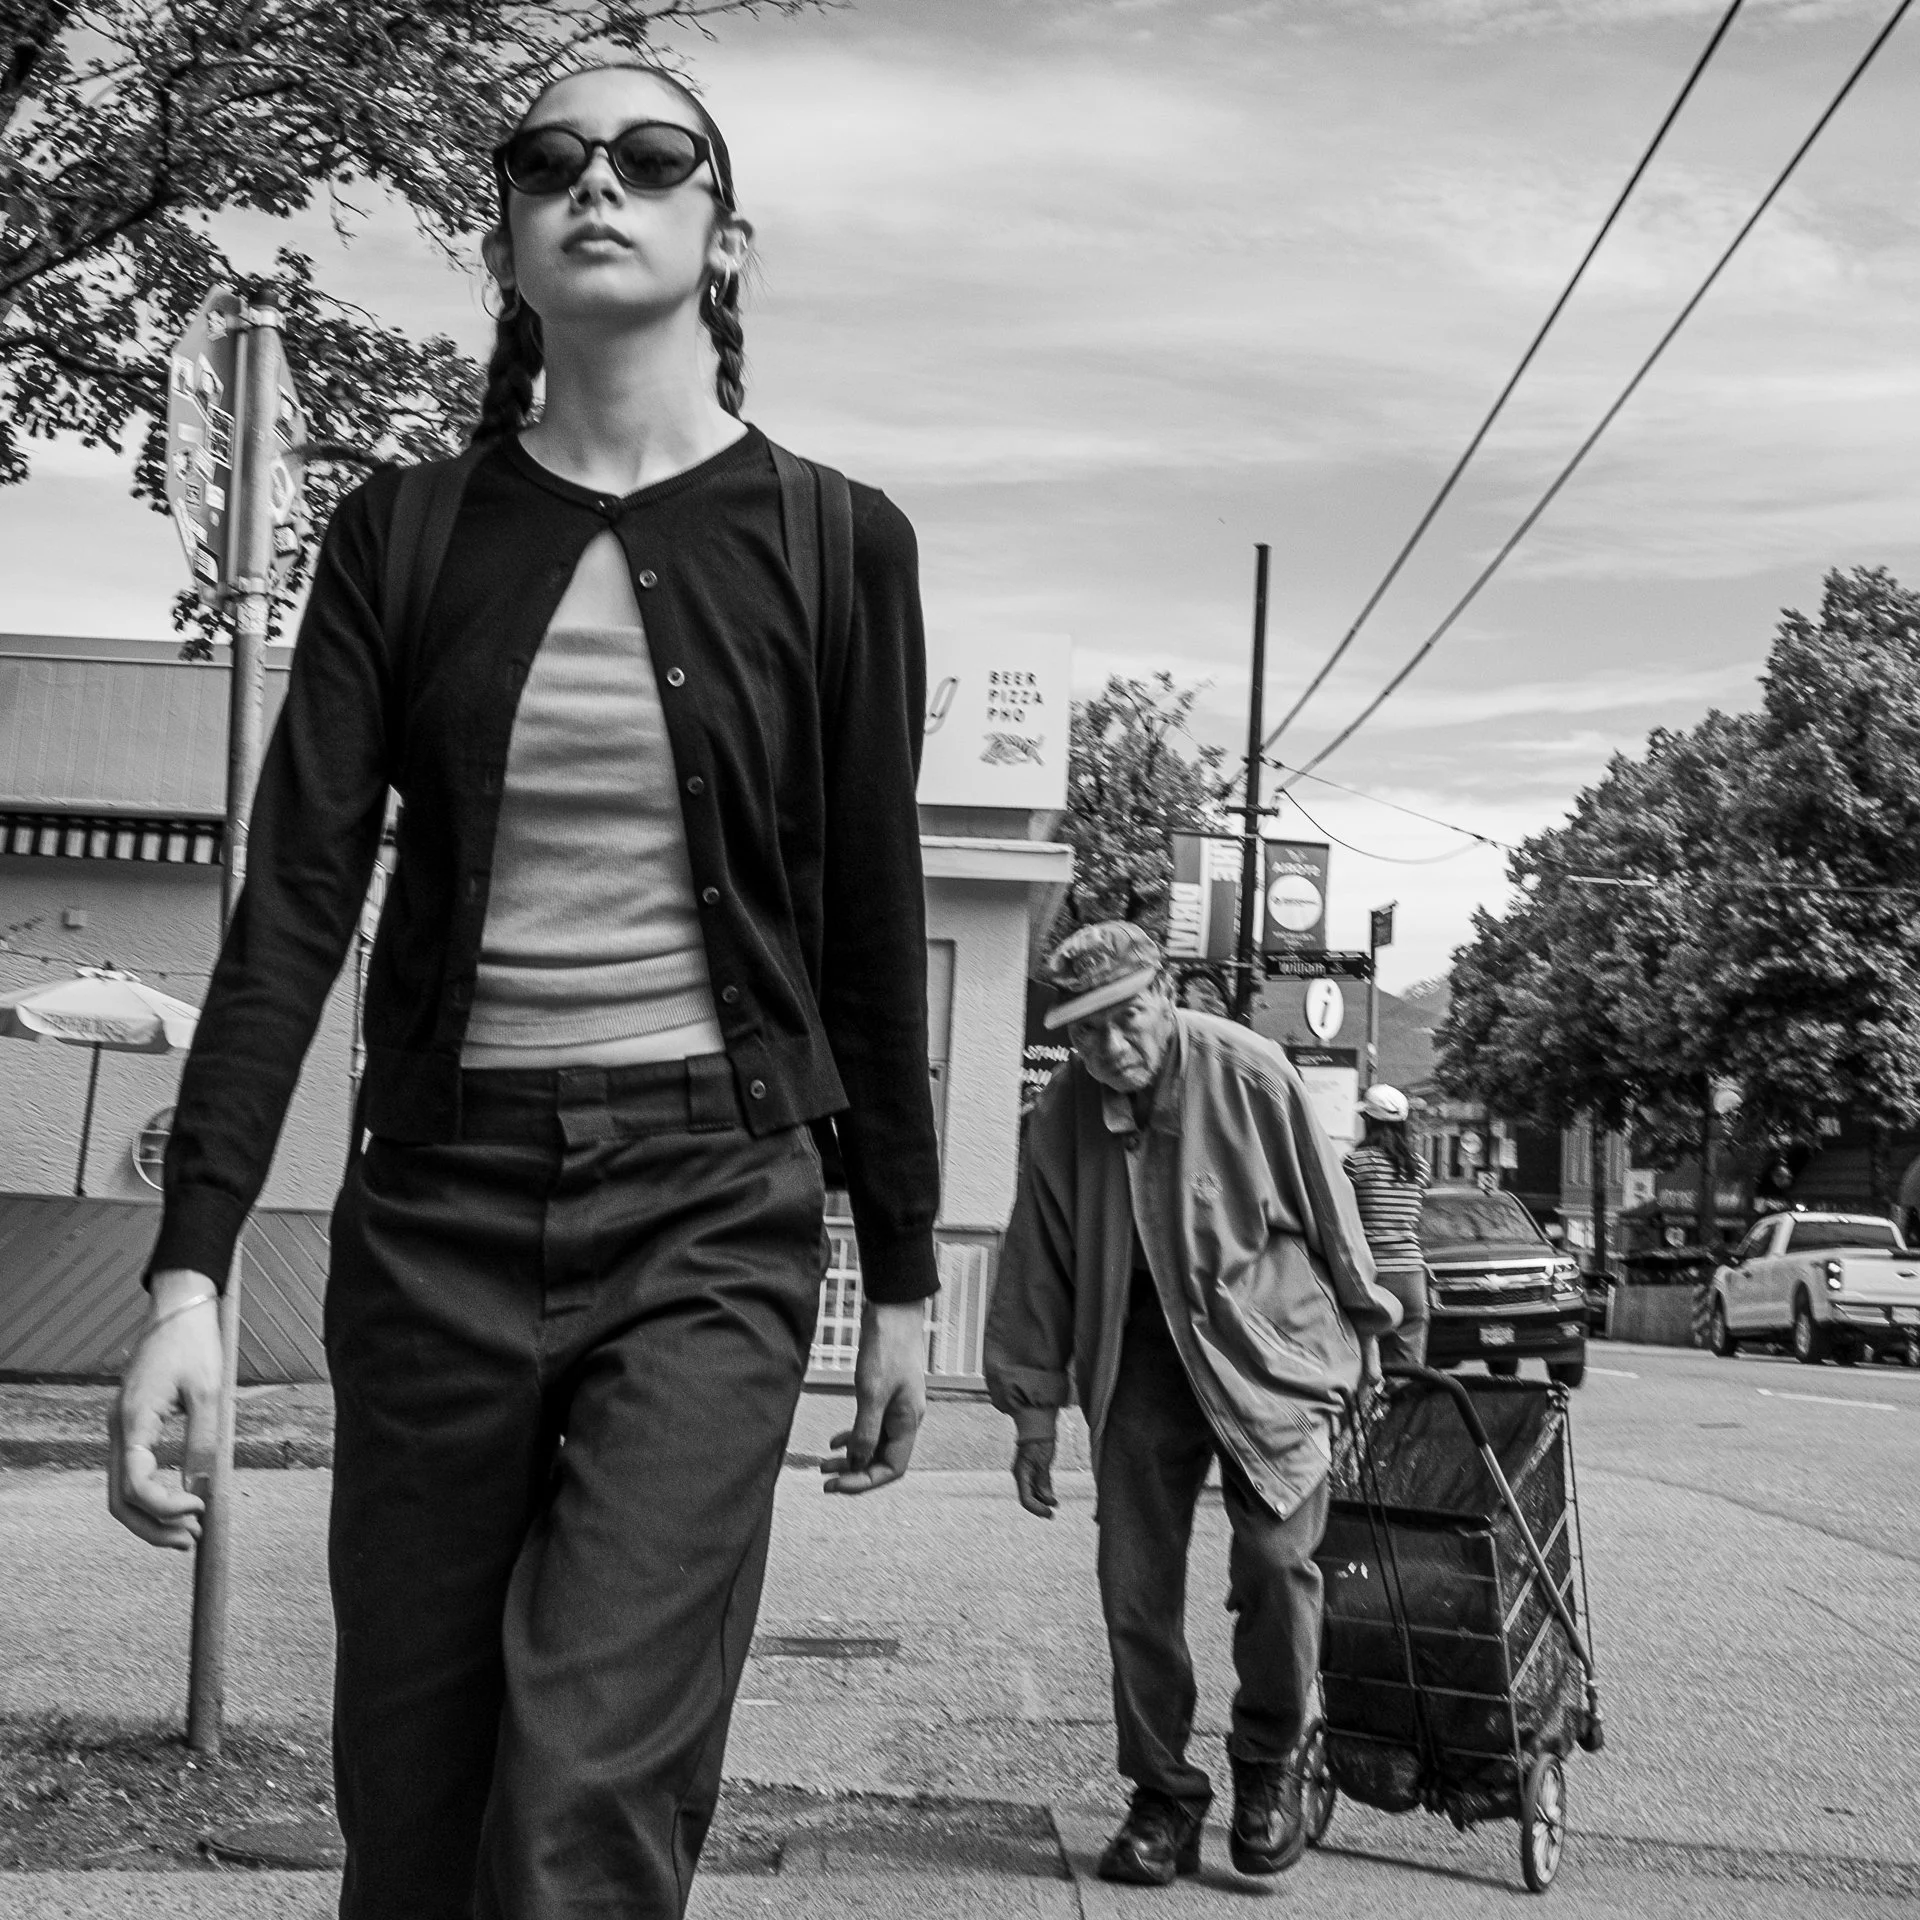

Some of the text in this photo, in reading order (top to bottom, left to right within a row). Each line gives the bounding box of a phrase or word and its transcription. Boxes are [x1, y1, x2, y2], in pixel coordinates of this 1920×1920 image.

[989, 671, 1037, 686] BEER
[987, 689, 1044, 705] PIZZA
[986, 707, 1026, 723] PHO
[1278, 960, 1326, 976] William
